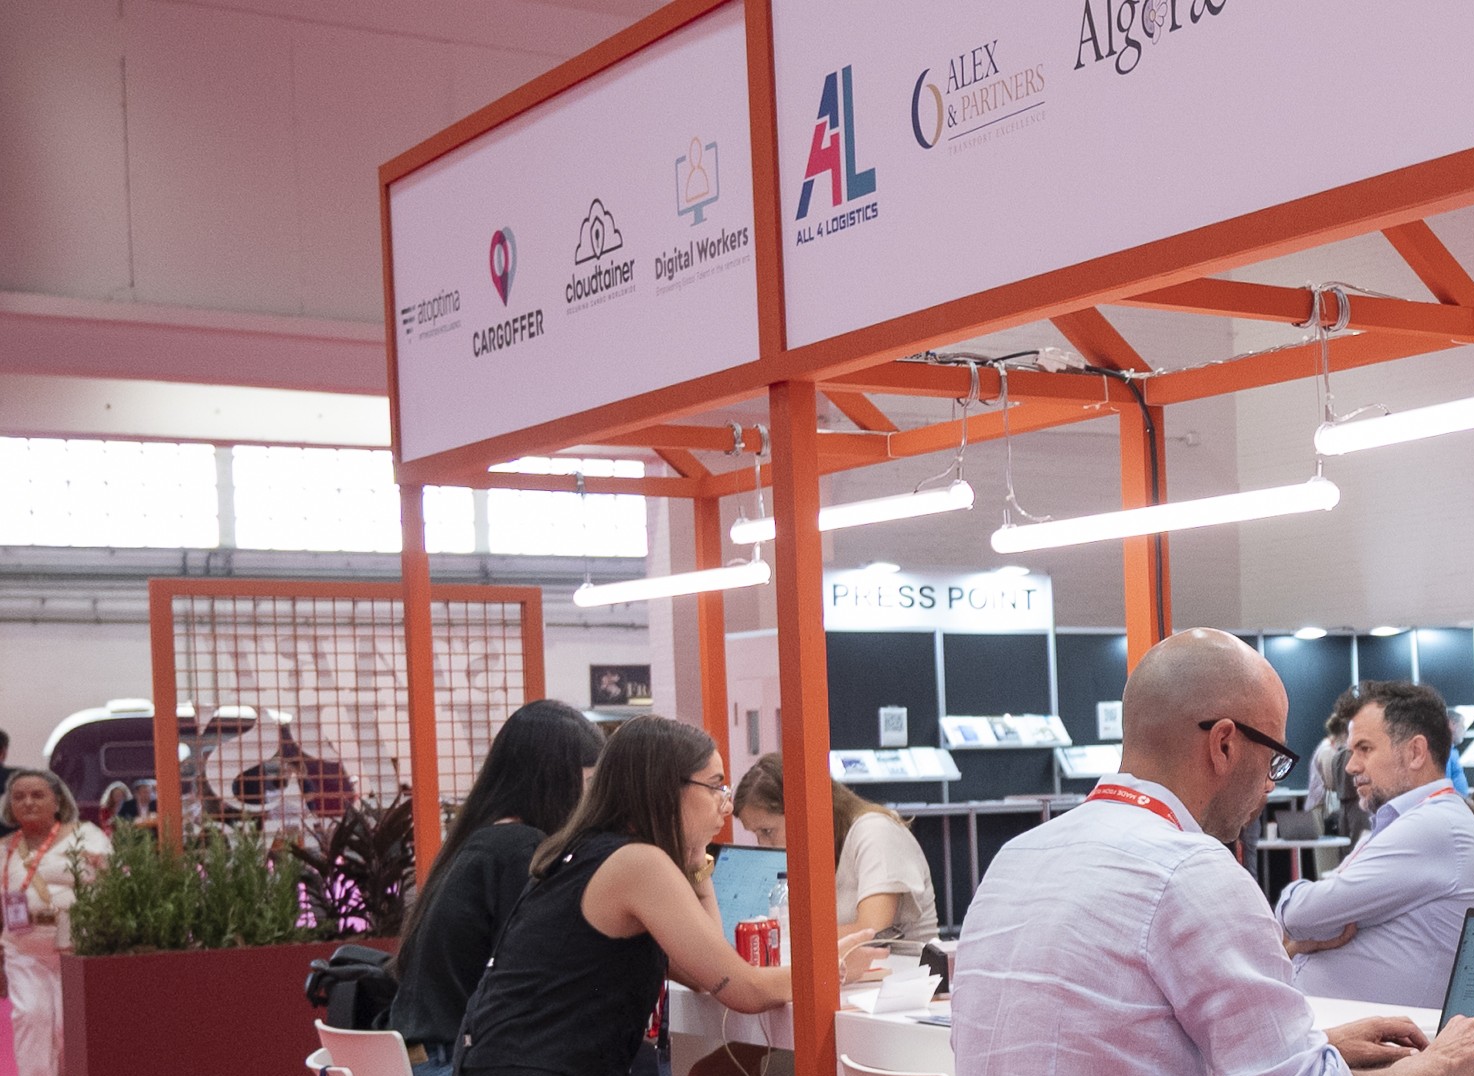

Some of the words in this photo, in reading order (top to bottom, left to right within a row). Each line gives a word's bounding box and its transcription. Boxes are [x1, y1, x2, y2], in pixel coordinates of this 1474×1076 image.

[946, 39, 999, 95] ALEX
[947, 104, 957, 128] &
[961, 63, 1045, 122] PARTNERS
[797, 226, 814, 246] ALL
[816, 222, 823, 238] 4
[826, 202, 878, 235] LOGISTICS
[655, 241, 694, 281] Digital
[696, 227, 749, 263] Workers
[565, 258, 635, 304] cloudtainer
[418, 289, 460, 326] atoptima
[472, 309, 545, 358] CARGOFFER
[832, 584, 936, 609] PRESS
[948, 587, 1037, 610] POINT
